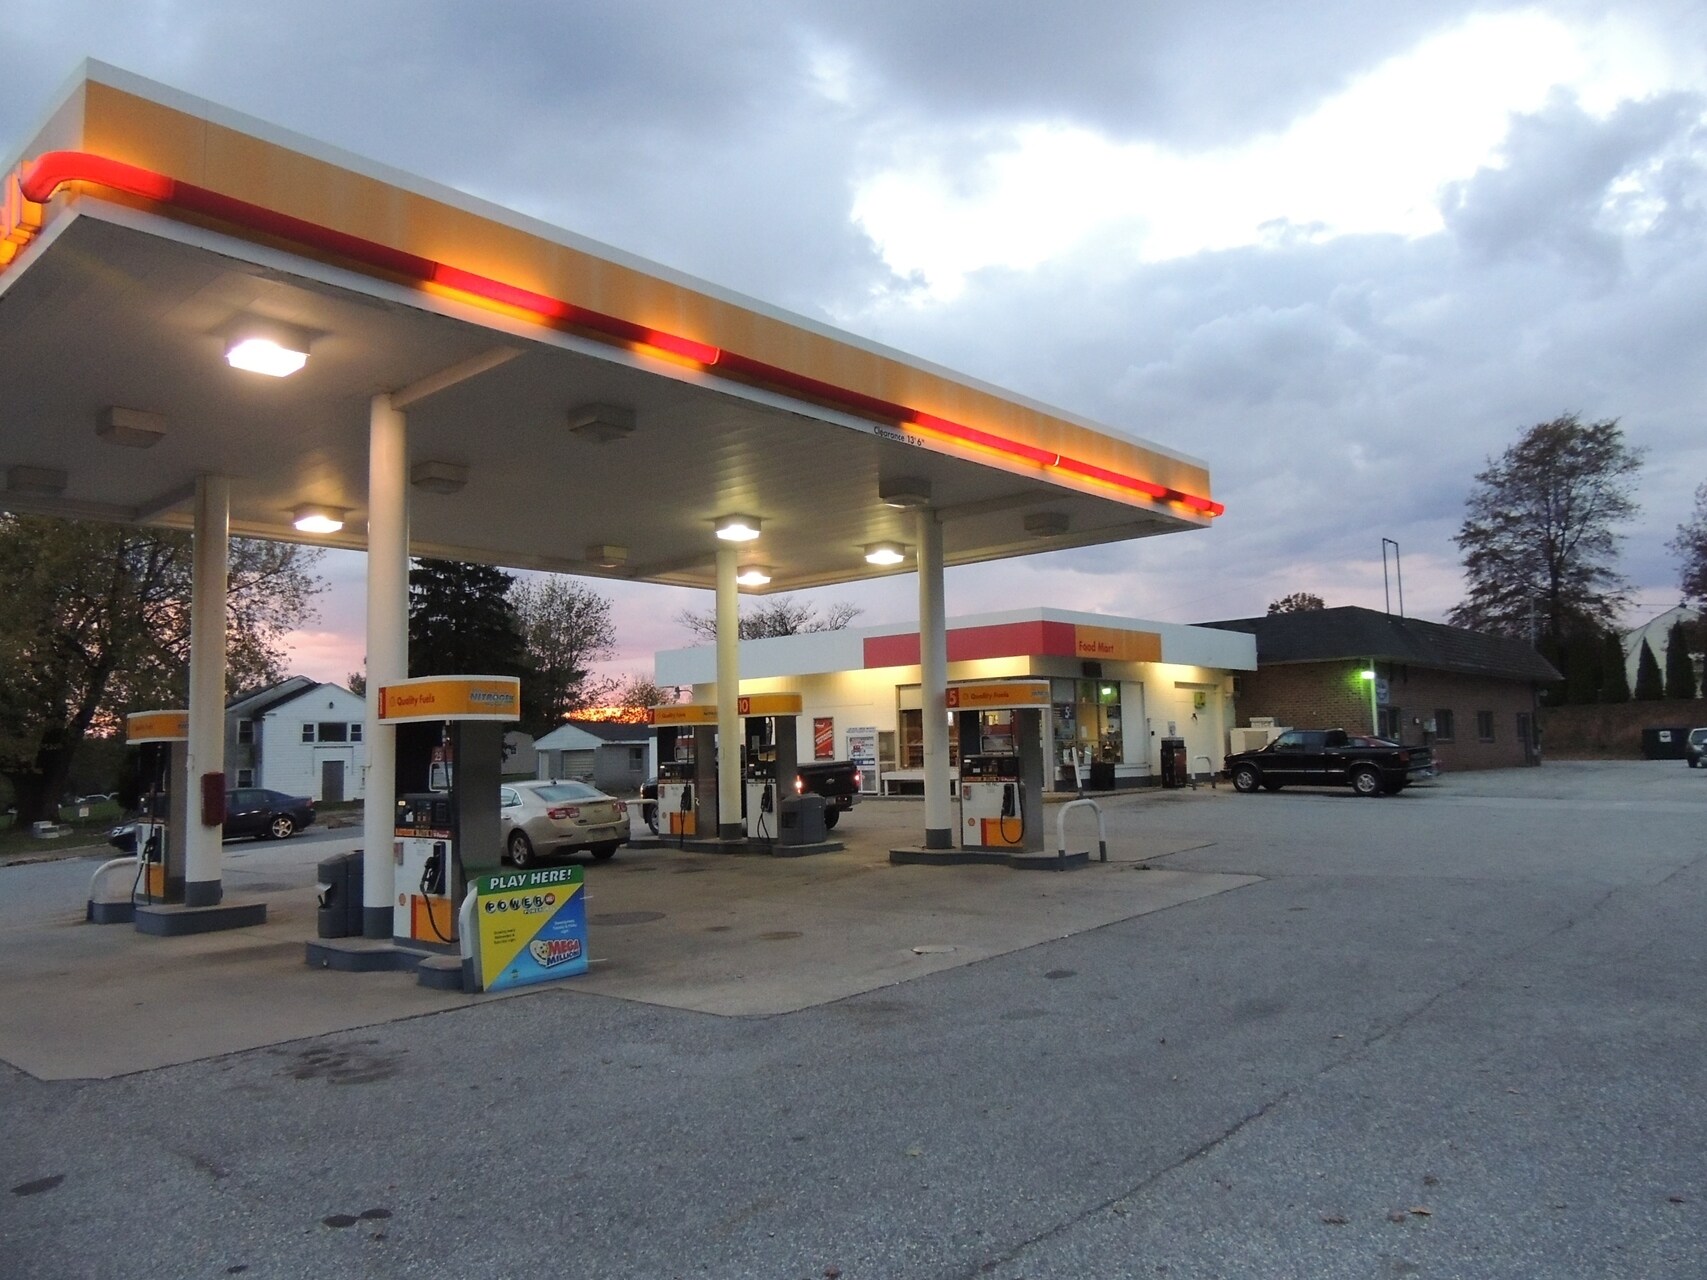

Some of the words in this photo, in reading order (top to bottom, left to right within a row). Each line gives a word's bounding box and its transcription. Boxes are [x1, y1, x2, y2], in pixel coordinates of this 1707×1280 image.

[873, 425, 905, 442] Clearance
[1079, 641, 1096, 652] Food
[1098, 642, 1114, 653] Mart
[396, 695, 418, 706] Quality
[419, 693, 436, 704] Fuels
[948, 690, 957, 705] 5
[970, 692, 992, 701] Quality
[738, 700, 748, 713] 10
[490, 874, 527, 890] PLAY
[531, 869, 572, 885] HERE!
[548, 939, 580, 957] MEGA
